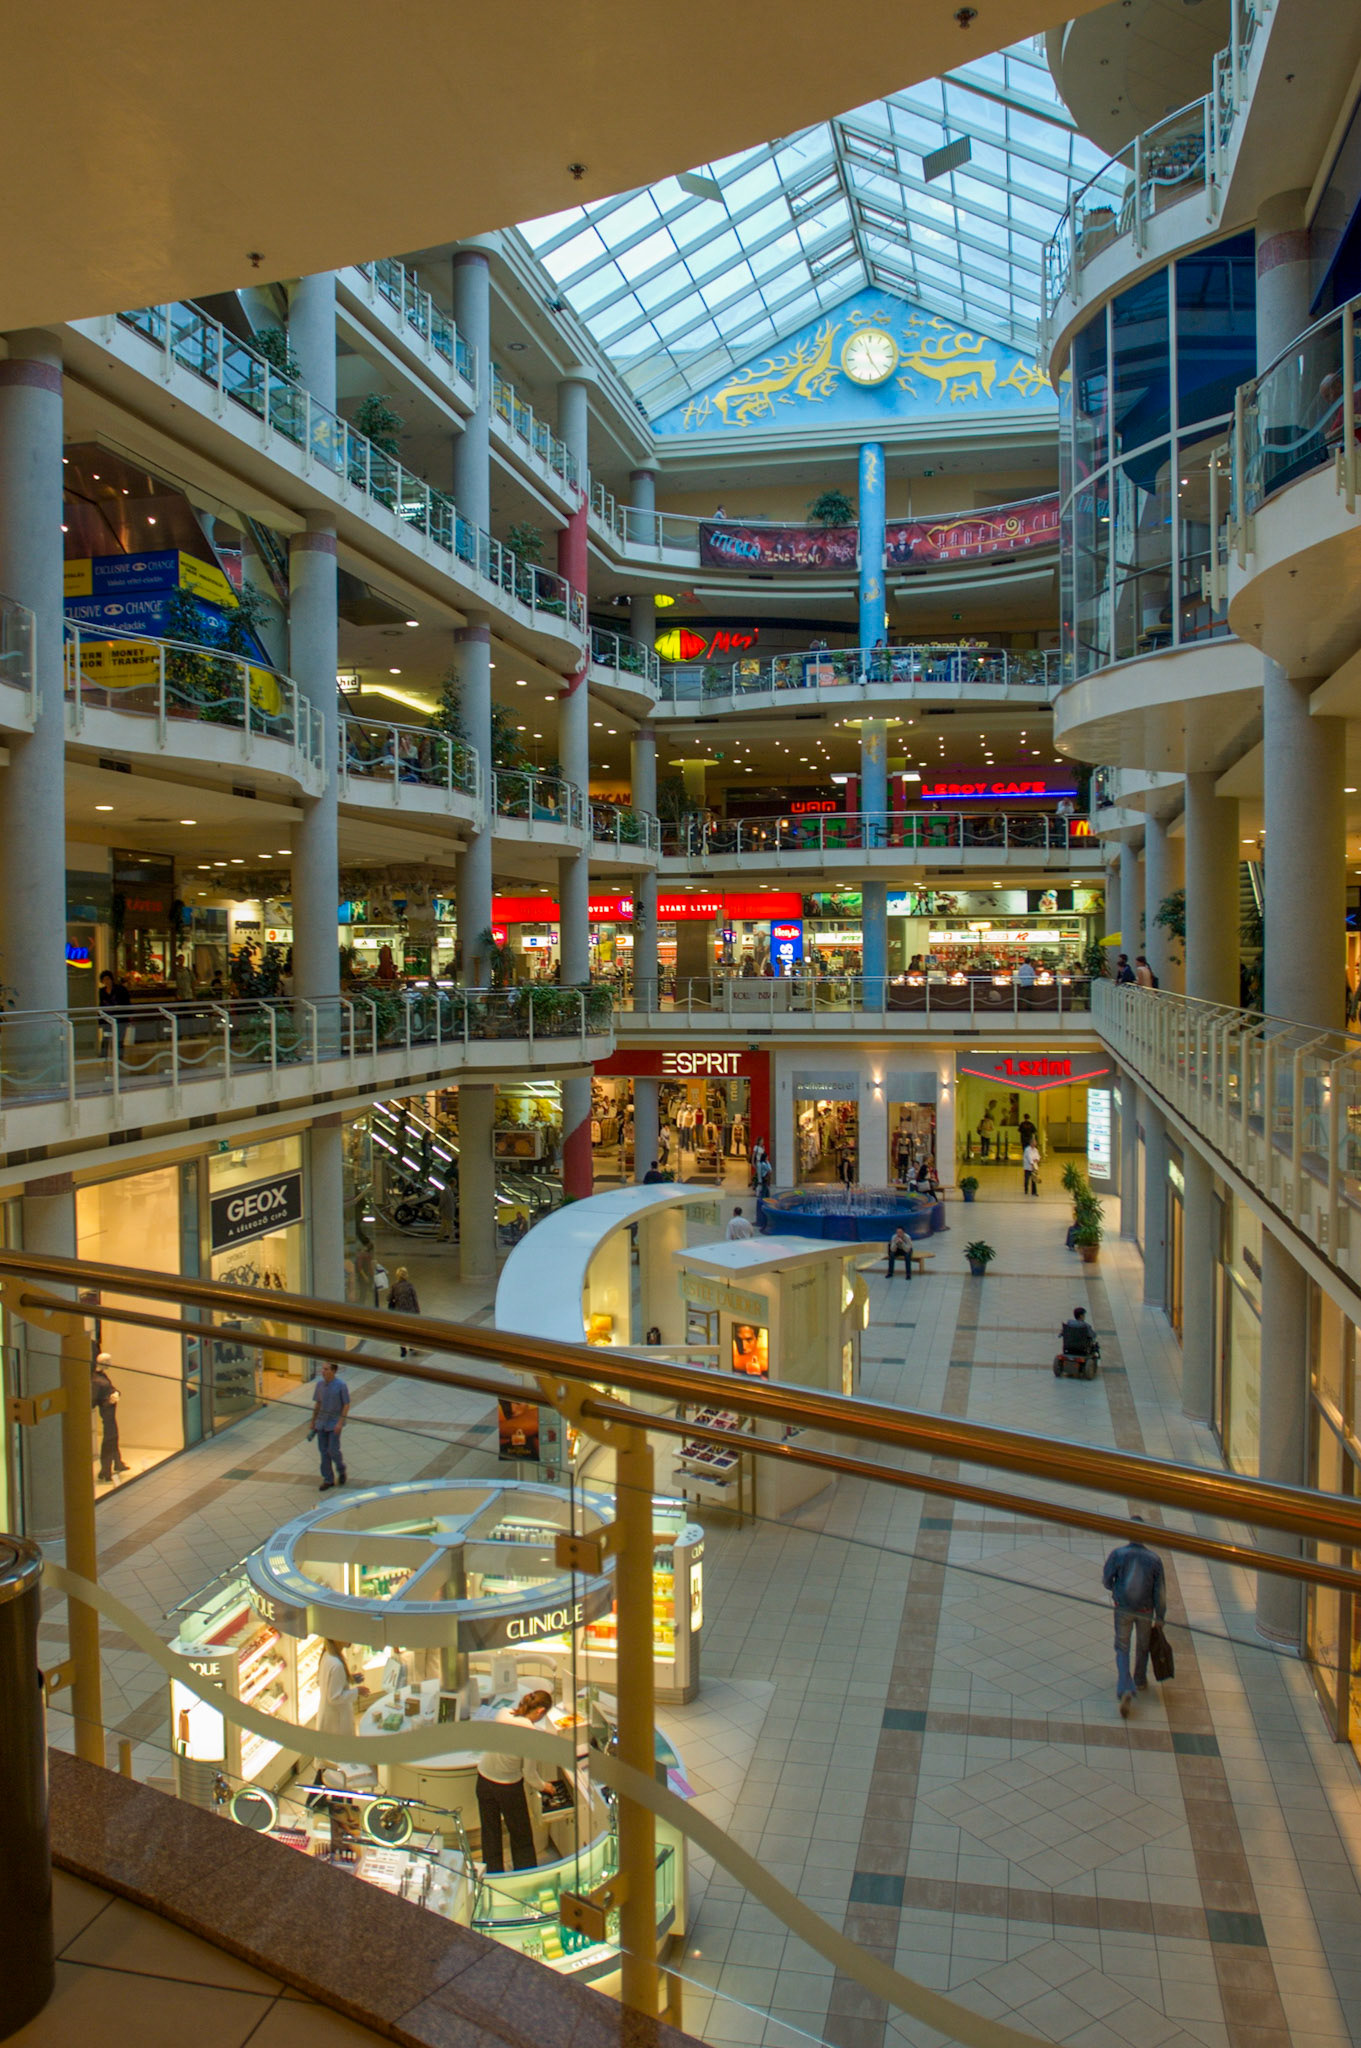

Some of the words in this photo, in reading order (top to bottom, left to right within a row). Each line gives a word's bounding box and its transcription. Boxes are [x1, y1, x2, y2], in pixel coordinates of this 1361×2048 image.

[1033, 511, 1059, 529] CLU
[94, 563, 131, 575] EXCLUSIVE
[147, 560, 175, 570] CHANGE
[125, 600, 163, 615] CHANGE
[111, 648, 145, 658] MONEY
[922, 783, 987, 795] LEROY
[659, 904, 687, 912] START
[662, 1052, 742, 1074] ESPRIT
[227, 1185, 288, 1222] GEOX
[506, 1603, 584, 1640] CLINIQUE
